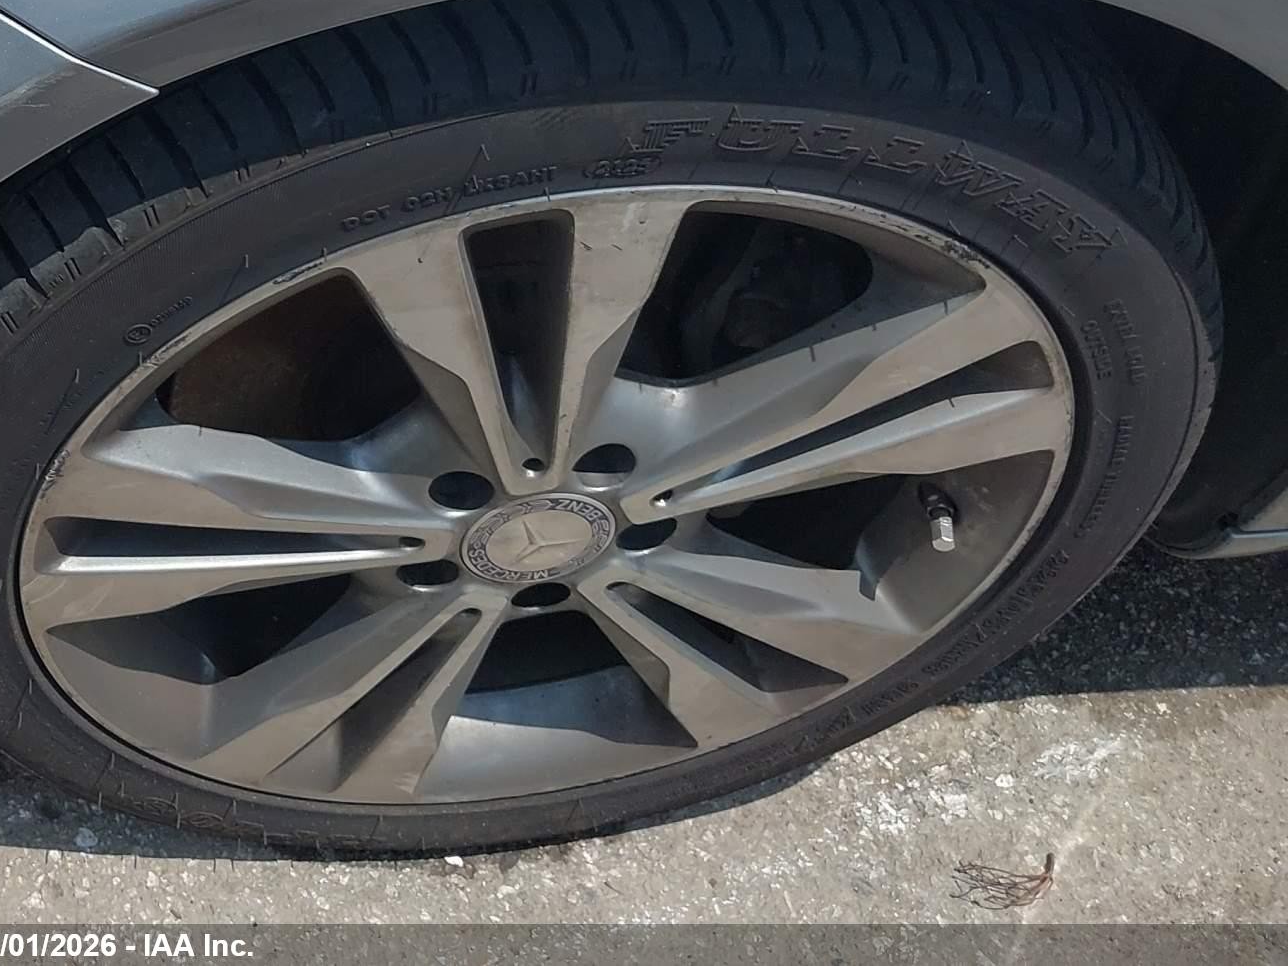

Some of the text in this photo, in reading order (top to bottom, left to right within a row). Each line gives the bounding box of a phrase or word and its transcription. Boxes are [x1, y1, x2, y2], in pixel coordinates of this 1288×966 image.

[632, 117, 1113, 254] FULLWAY
[556, 498, 602, 523] BENZ
[468, 548, 550, 582] MERCEDES
